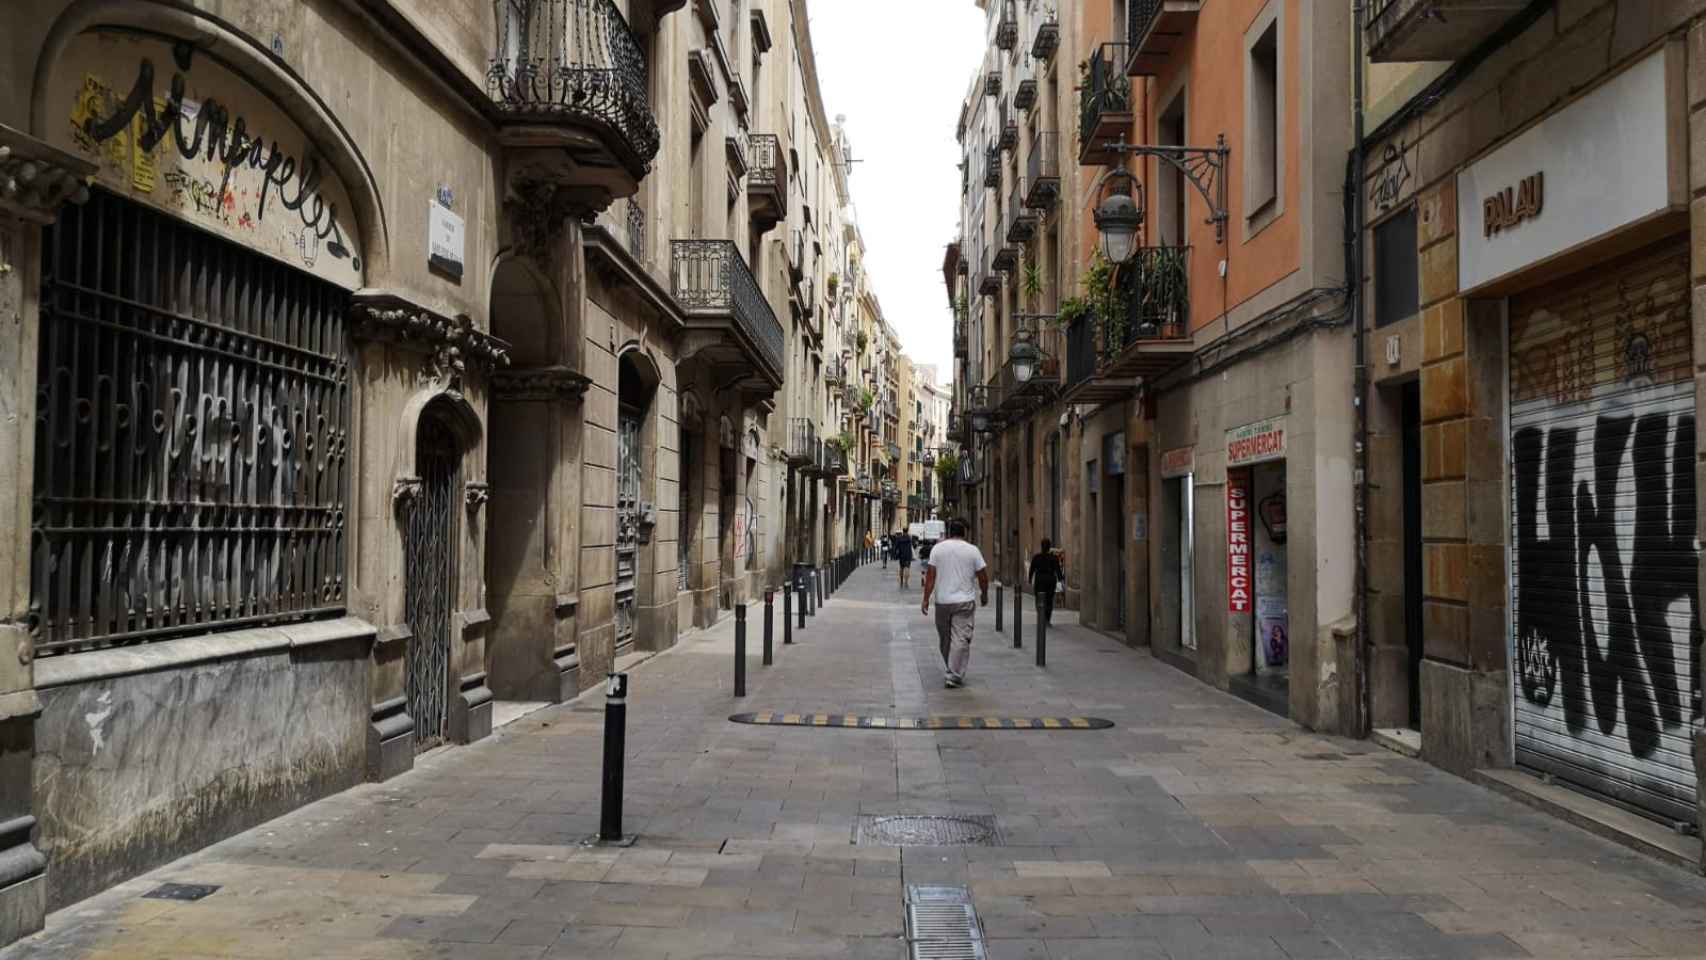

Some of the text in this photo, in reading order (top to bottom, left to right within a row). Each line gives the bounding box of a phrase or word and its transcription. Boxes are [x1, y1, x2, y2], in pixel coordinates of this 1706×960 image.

[1483, 171, 1543, 239] PALAU
[1228, 429, 1284, 461] SUPERMERCAT
[1228, 488, 1249, 611] SUPERMERCAT
